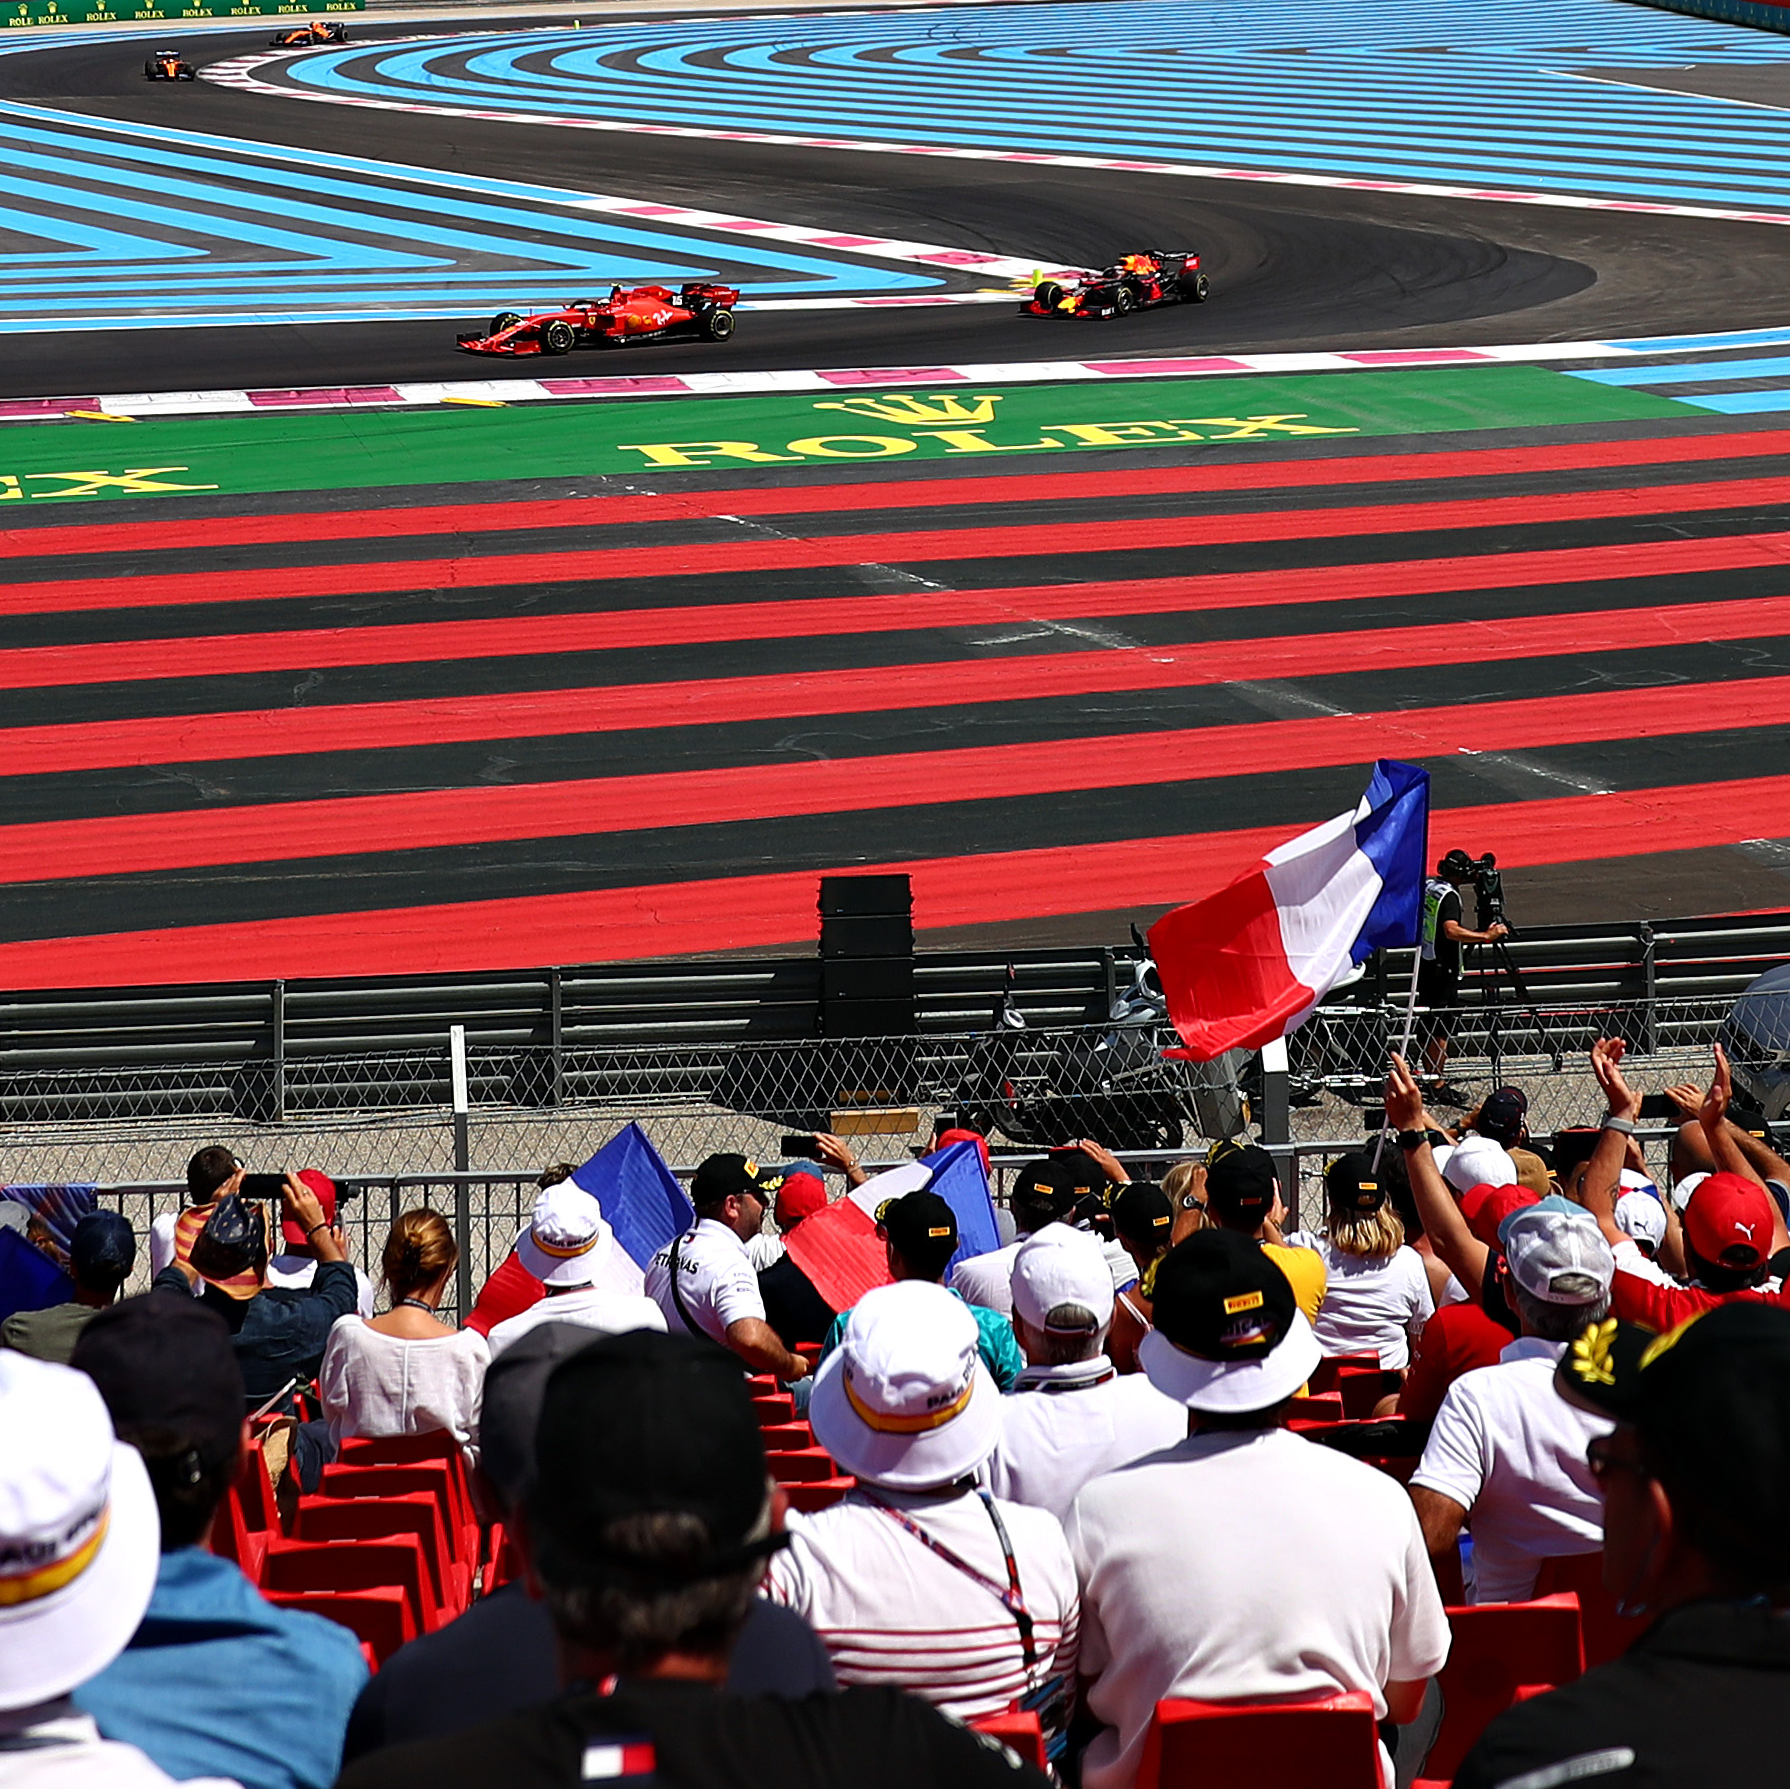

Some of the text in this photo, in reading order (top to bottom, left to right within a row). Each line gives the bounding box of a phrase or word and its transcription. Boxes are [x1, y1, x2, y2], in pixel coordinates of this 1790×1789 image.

[9, 1, 357, 27] ROLE ROLEX ROLEX ROLEX ROLEX ROLEX ROLEX ROLEX
[617, 413, 1361, 467] ROLEX
